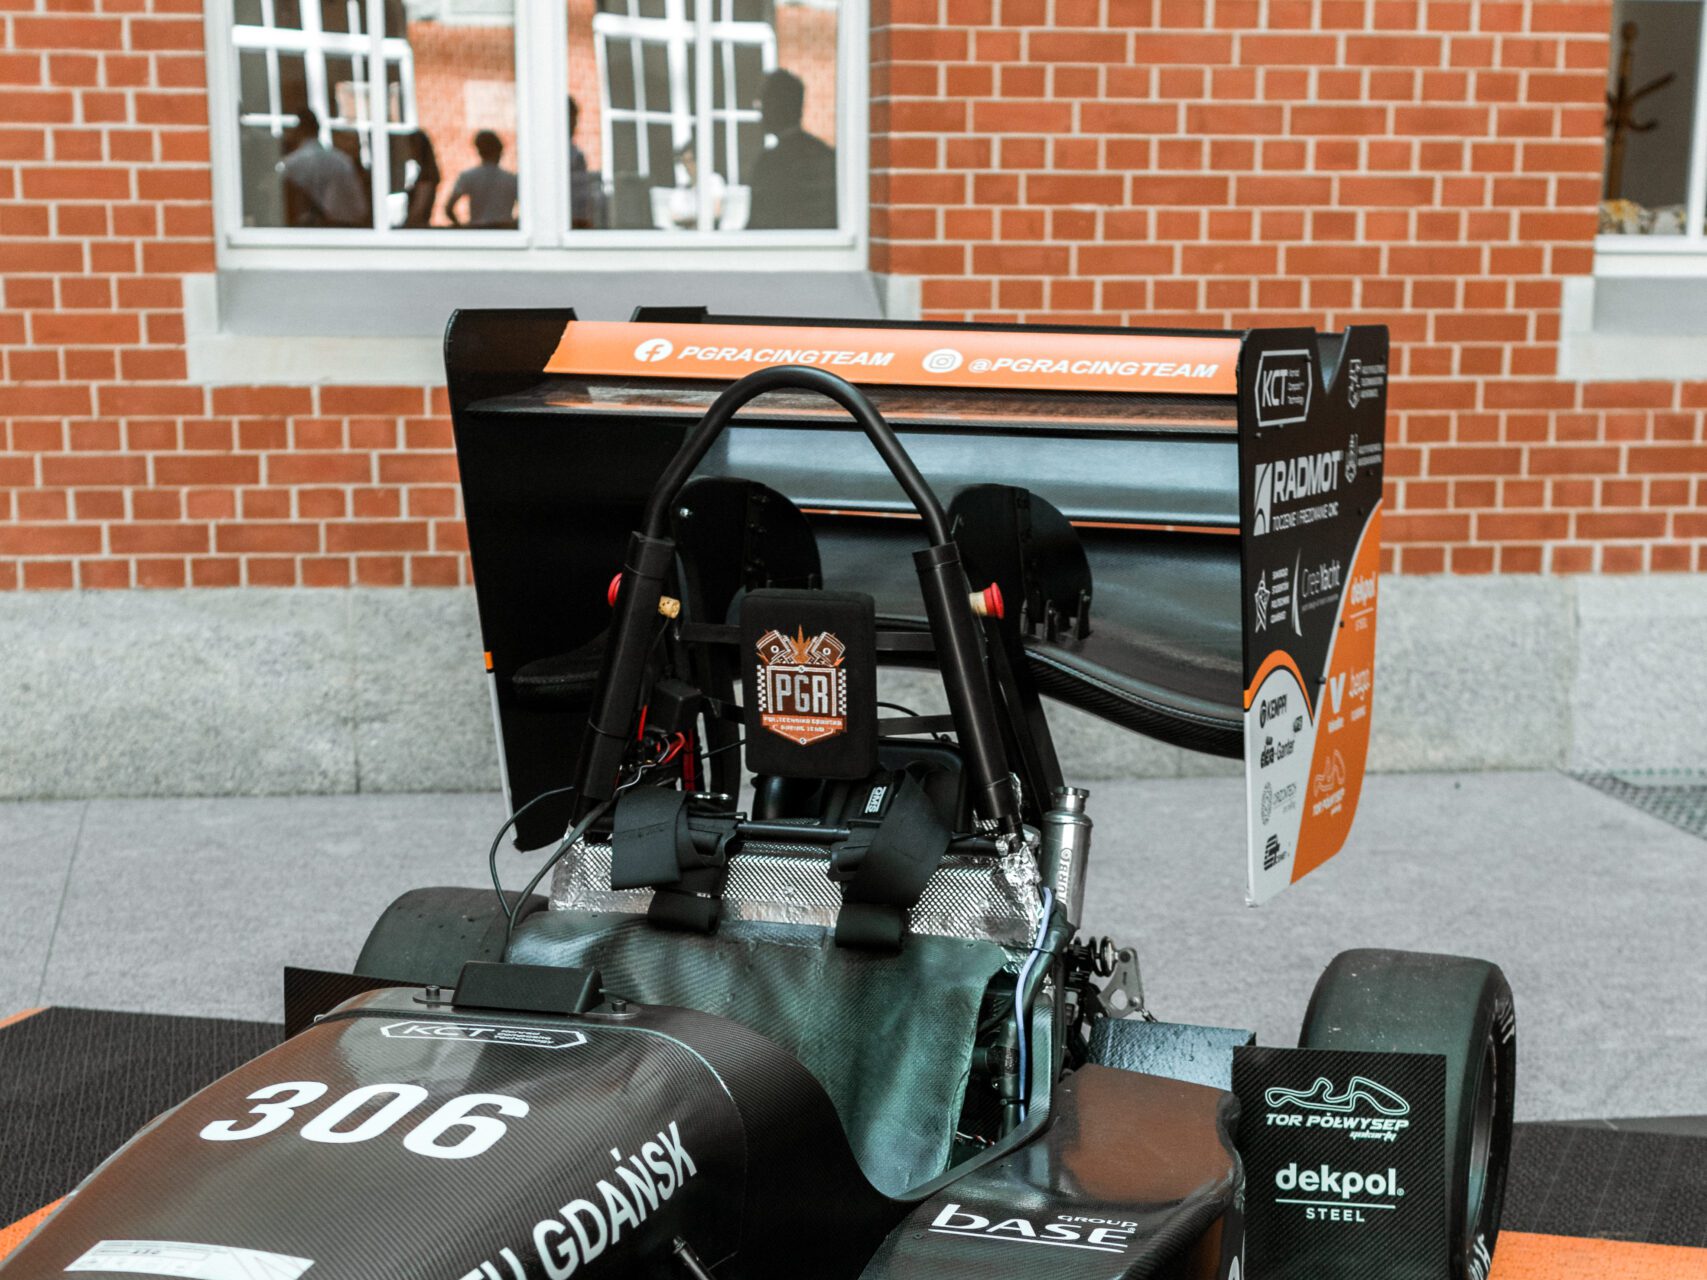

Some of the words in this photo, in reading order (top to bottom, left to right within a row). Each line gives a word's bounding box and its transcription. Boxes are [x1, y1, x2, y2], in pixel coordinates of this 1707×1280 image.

[678, 346, 895, 366] PGRACINGTEAM
[968, 358, 1218, 378] @PGRACINGTEAM
[1262, 369, 1288, 407] KCT
[1273, 450, 1344, 503] RADMOT
[775, 673, 829, 713] PGR
[403, 1025, 495, 1037] KCT
[199, 1080, 530, 1159] 306
[1266, 1113, 1303, 1127] TOR
[1306, 1112, 1409, 1132] PÓŁWYSEP
[1306, 1207, 1366, 1223] STEEL
